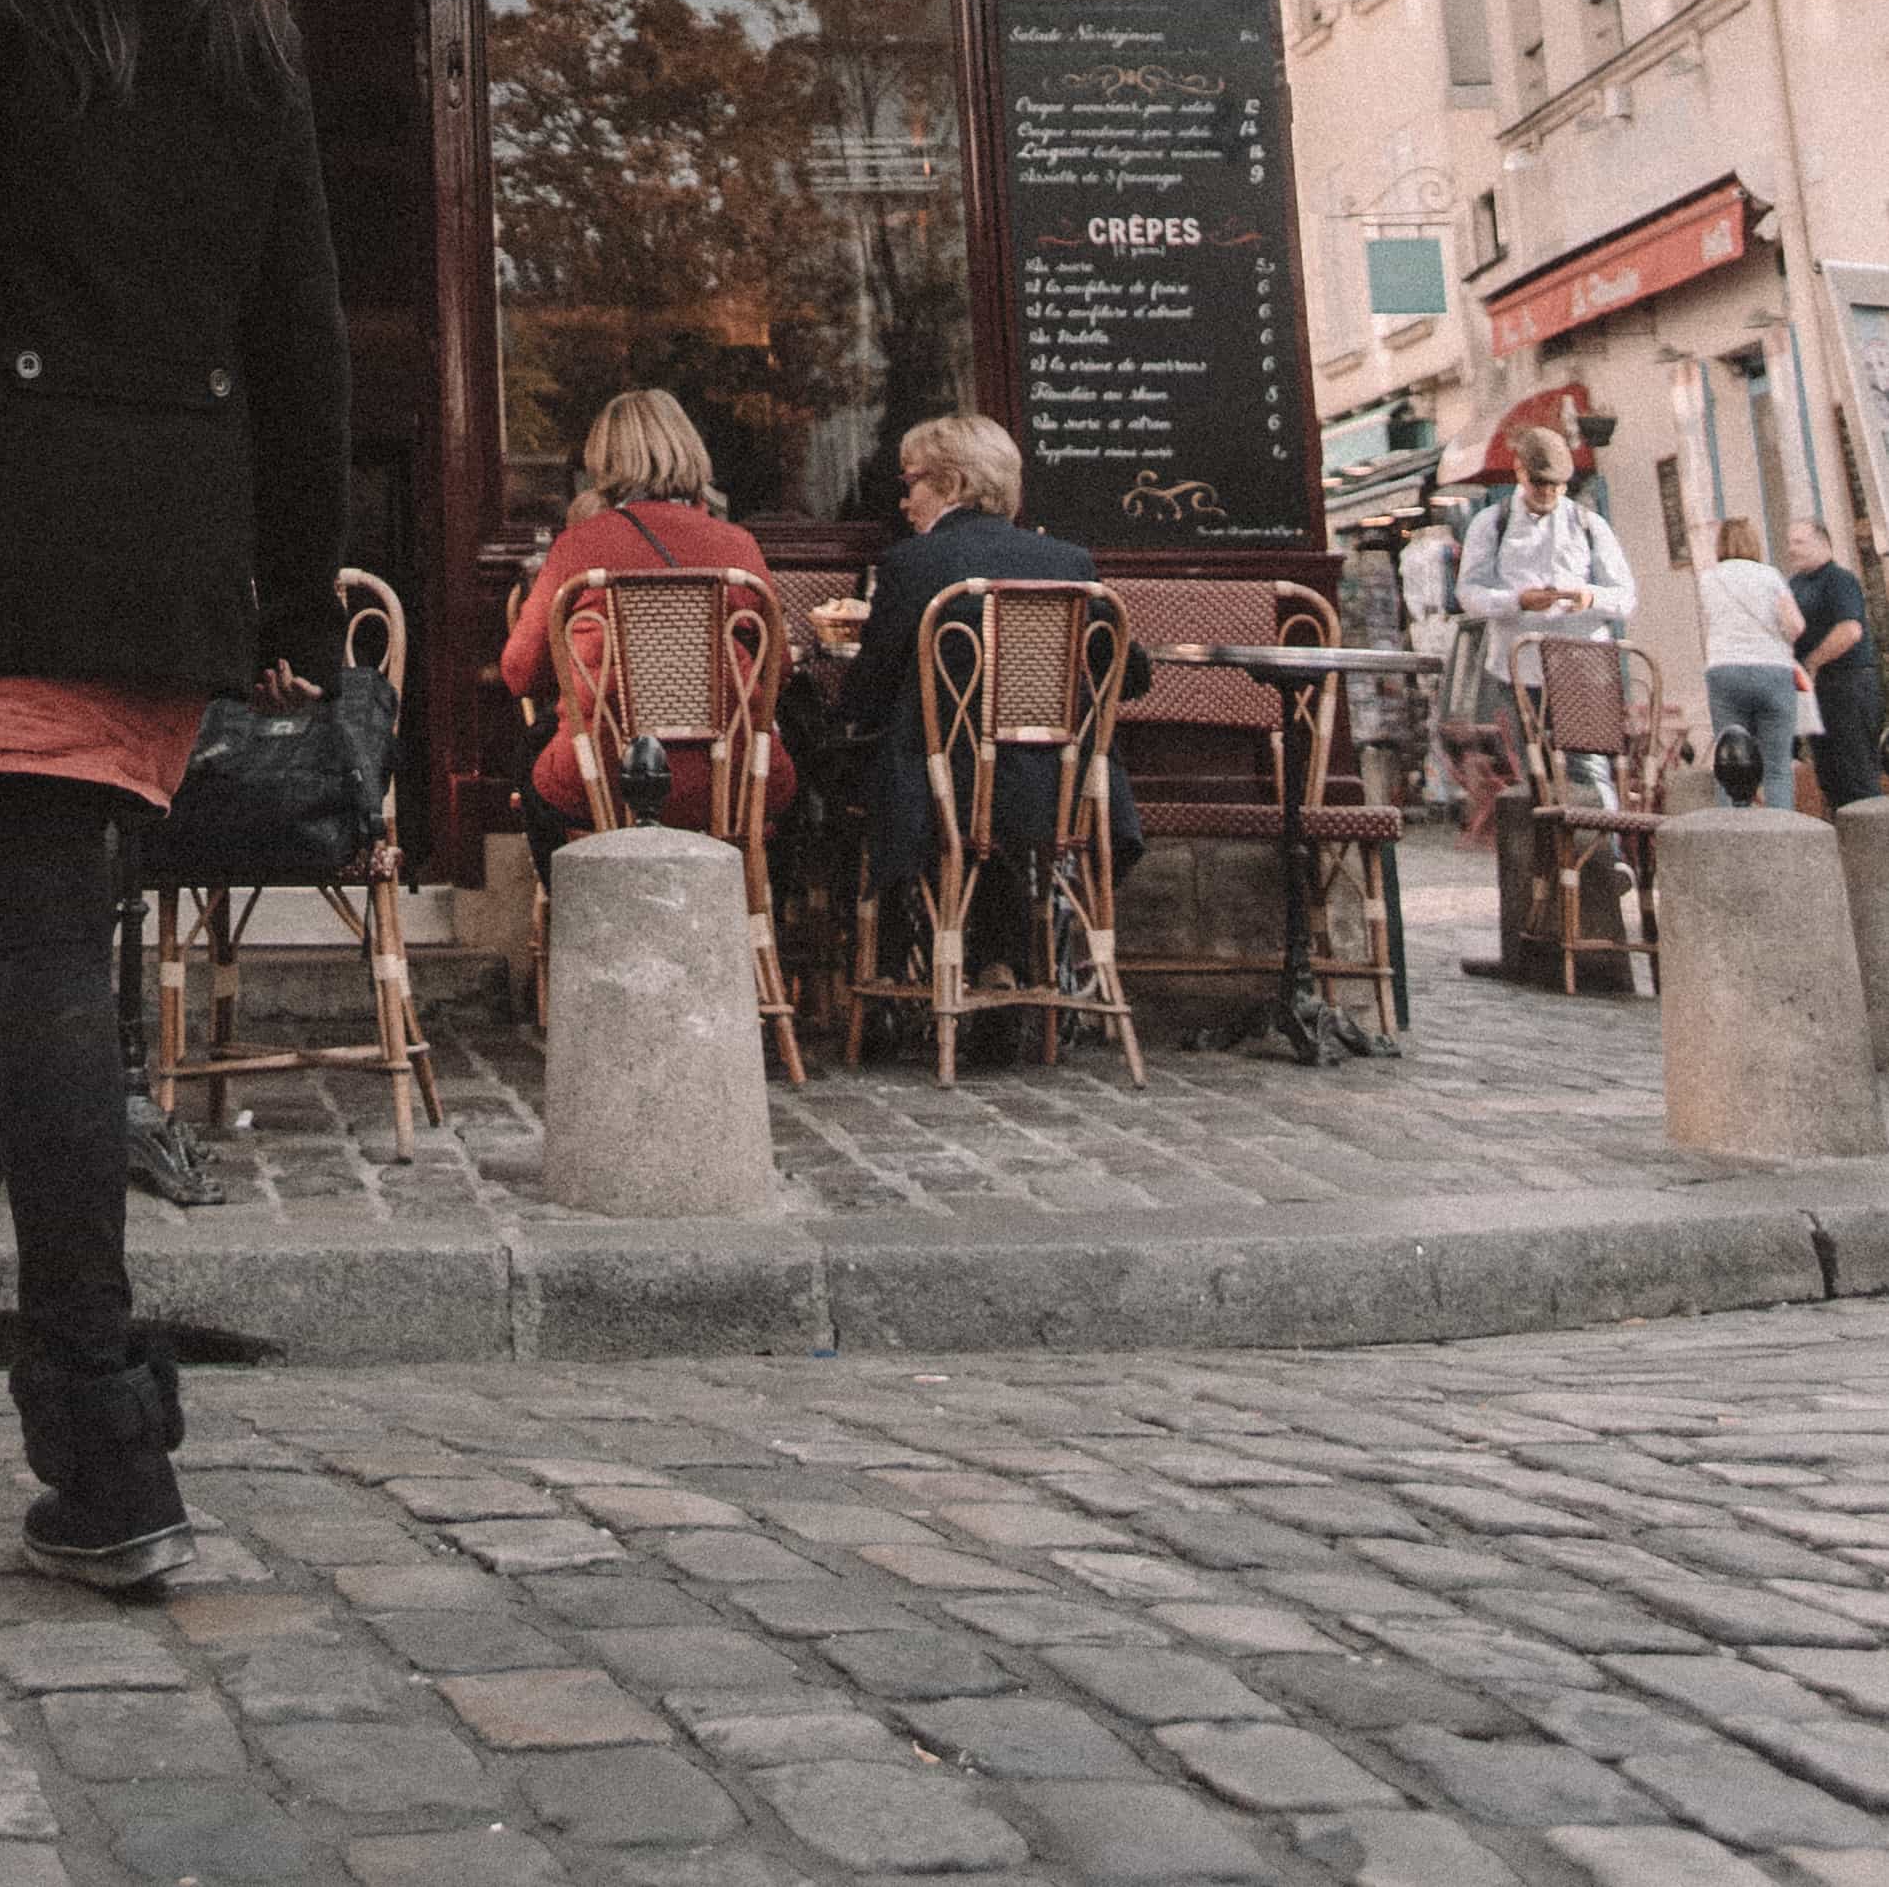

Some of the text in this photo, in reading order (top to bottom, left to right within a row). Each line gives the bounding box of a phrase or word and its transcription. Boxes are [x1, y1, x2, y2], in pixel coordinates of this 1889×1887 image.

[1009, 25, 1062, 43] Salade
[1088, 213, 1202, 246] CRÊPES
[1262, 355, 1277, 372] 6
[1267, 413, 1282, 431] 6
